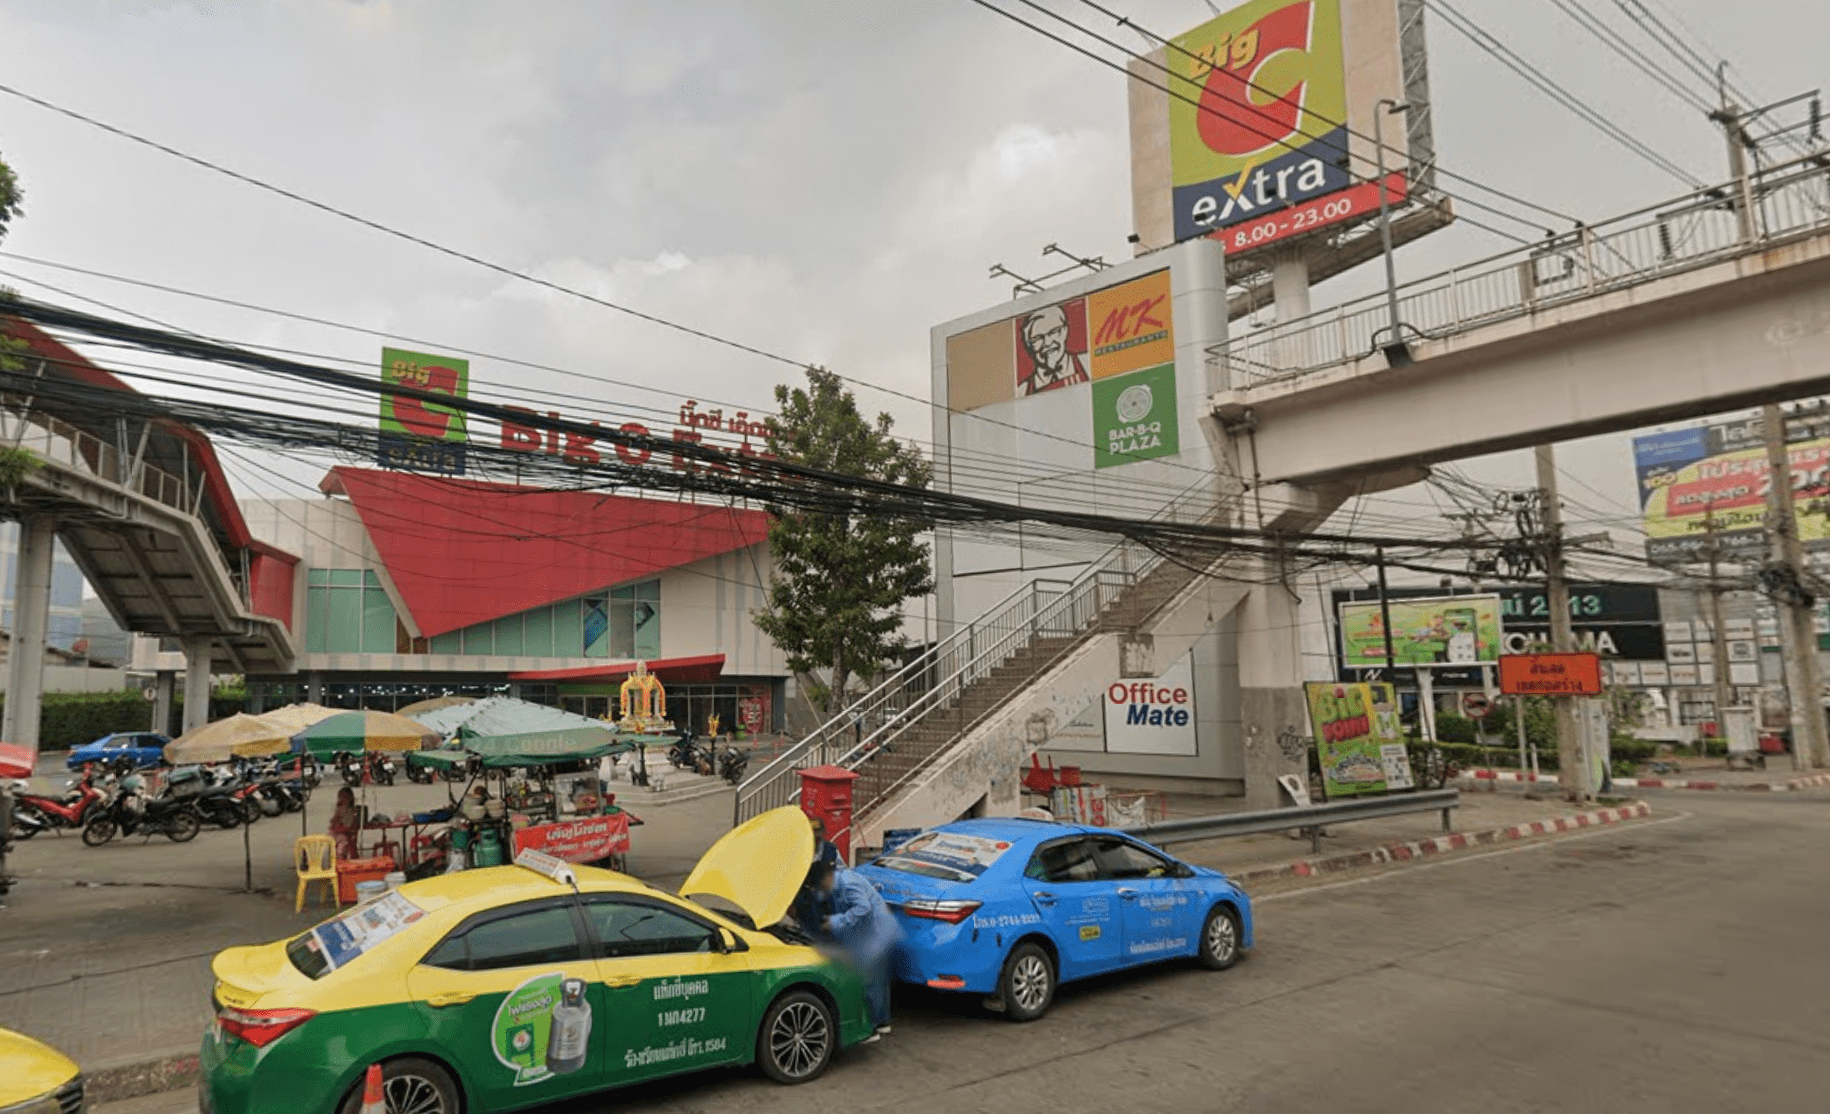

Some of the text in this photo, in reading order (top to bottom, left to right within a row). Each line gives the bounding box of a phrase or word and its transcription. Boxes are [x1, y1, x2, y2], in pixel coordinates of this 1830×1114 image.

[1190, 29, 1259, 79] Big
[1196, 1, 1315, 157] C
[1192, 157, 1326, 226] extra
[1234, 221, 1277, 247] 8.00
[1292, 198, 1352, 230] 23.00
[1095, 294, 1165, 345] MK
[391, 361, 431, 387] Big
[1109, 421, 1161, 441] BAR-B-Q
[1110, 434, 1162, 456] PLAZA
[1530, 594, 1602, 617] 213
[1108, 682, 1188, 705] Office
[1126, 703, 1189, 727] Mate
